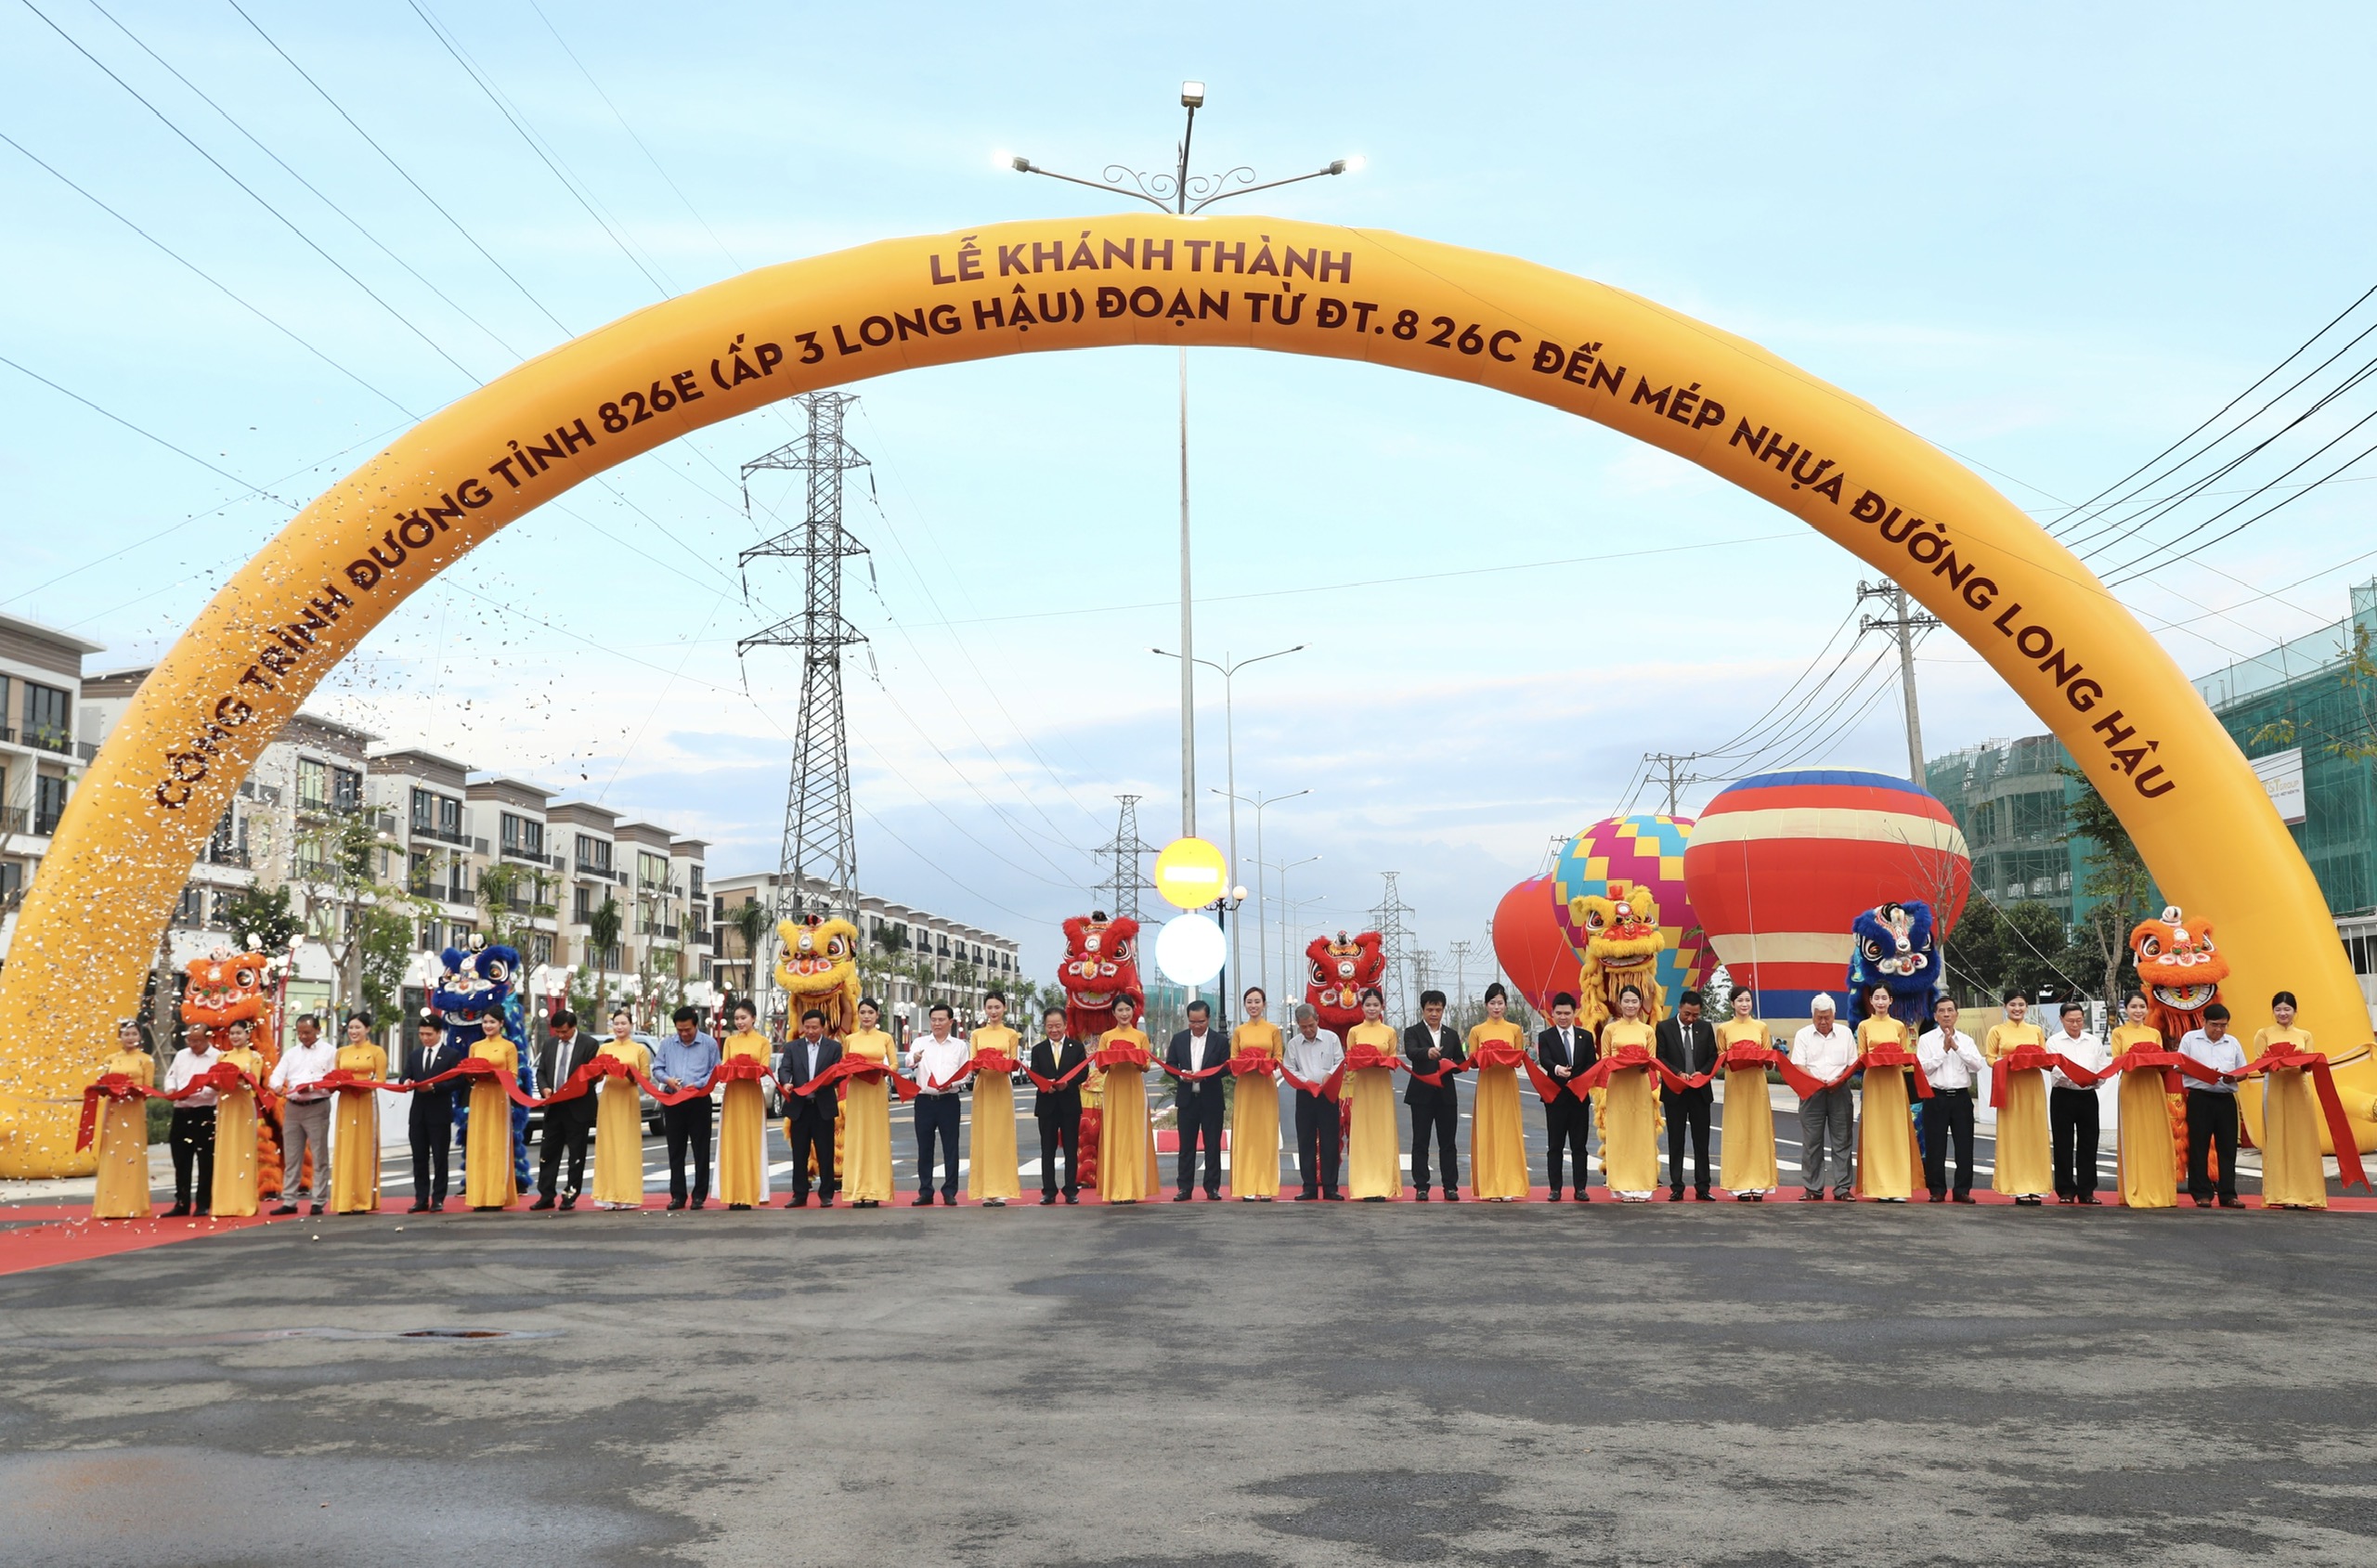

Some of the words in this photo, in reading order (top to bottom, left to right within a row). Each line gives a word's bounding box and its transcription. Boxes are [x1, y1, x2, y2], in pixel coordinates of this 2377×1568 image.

[930, 236, 984, 285] LỄ
[998, 230, 1174, 277] KHÁNH
[1184, 235, 1352, 283] THÀNH
[239, 583, 355, 692] TRÌNH
[344, 478, 494, 591] ĐƯỜNG
[488, 439, 597, 488] TỈNH
[598, 370, 704, 434] 826E
[710, 333, 783, 390] (ẤP
[795, 331, 825, 364] 3
[833, 305, 962, 356] LONG
[972, 283, 1085, 332] HẬU)
[1097, 286, 1229, 326] ĐOẠN
[1243, 281, 1306, 326] TỪ
[1532, 341, 1627, 396] ĐẾN
[1630, 382, 1725, 431] MÉP
[1729, 416, 1845, 505] NHỰA
[1850, 489, 1998, 612] ĐƯỜNG
[1993, 603, 2103, 712] LONG
[2092, 710, 2176, 798] HẬU
